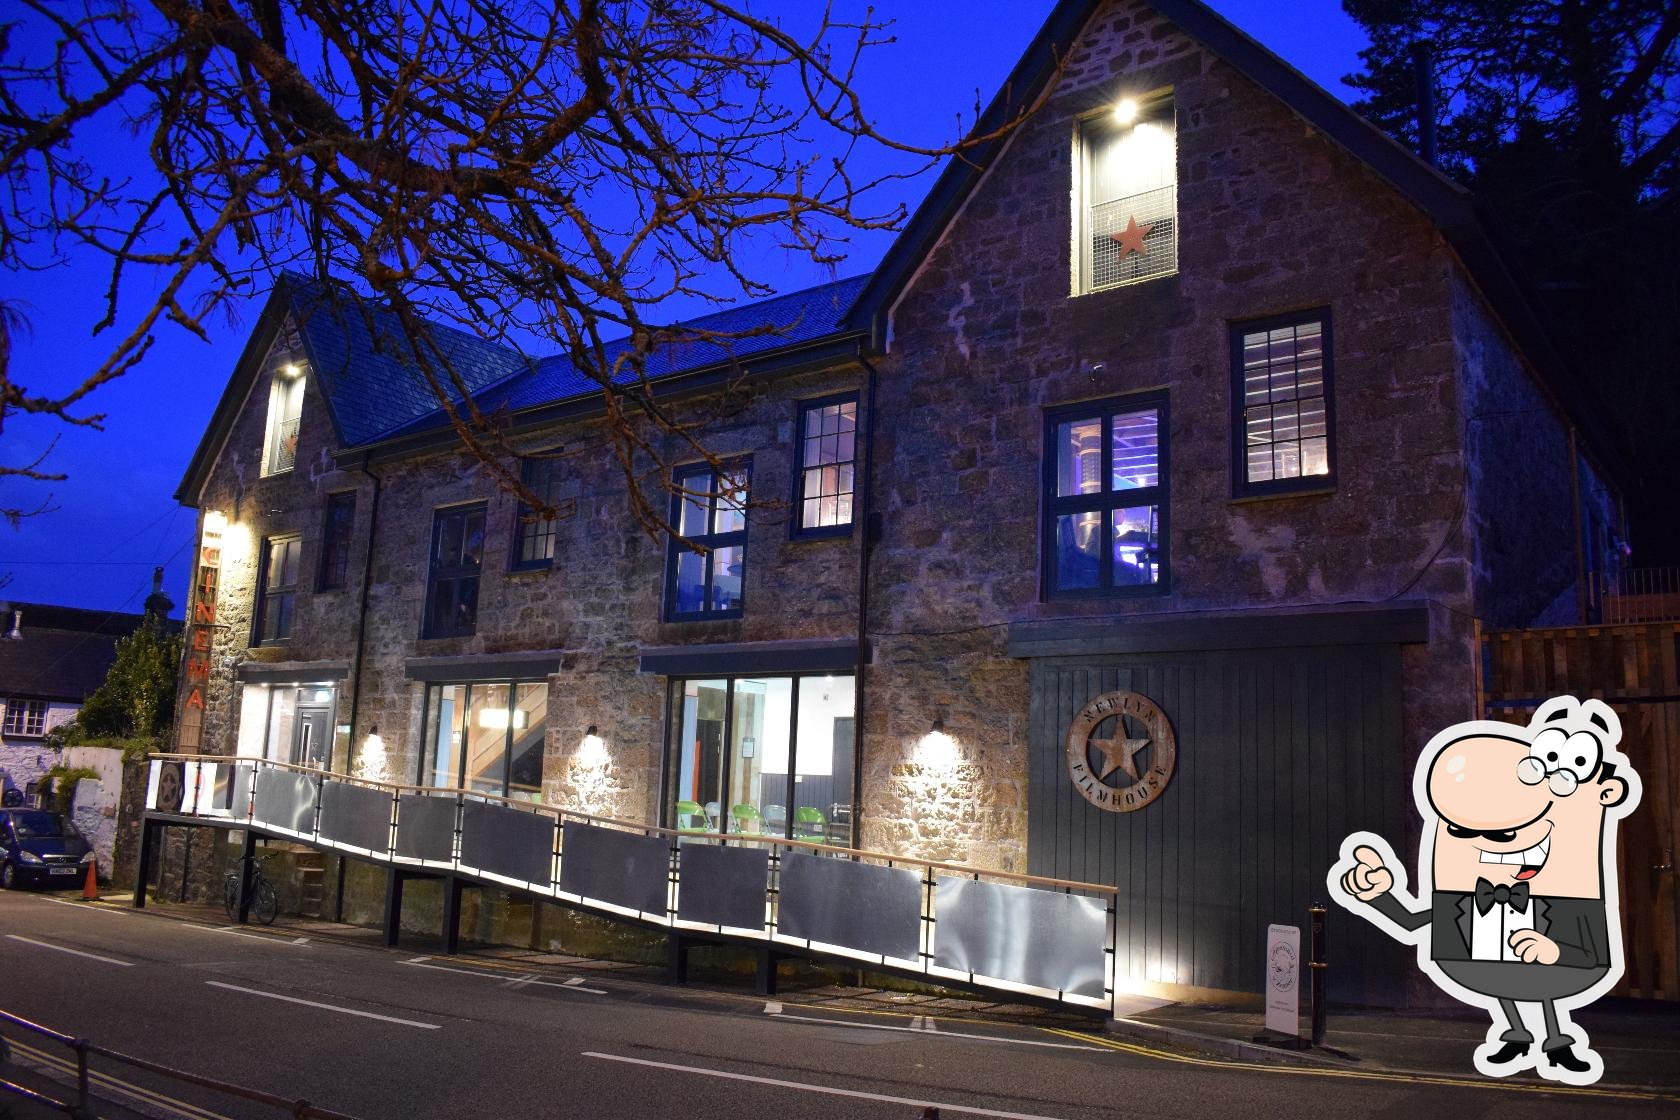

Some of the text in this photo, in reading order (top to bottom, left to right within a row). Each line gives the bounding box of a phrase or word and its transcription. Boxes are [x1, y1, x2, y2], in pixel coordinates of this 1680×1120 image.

[185, 546, 221, 710] CINEMA
[1083, 697, 1157, 723] NEWLYN
[1073, 763, 1167, 806] FILMHOUSE
